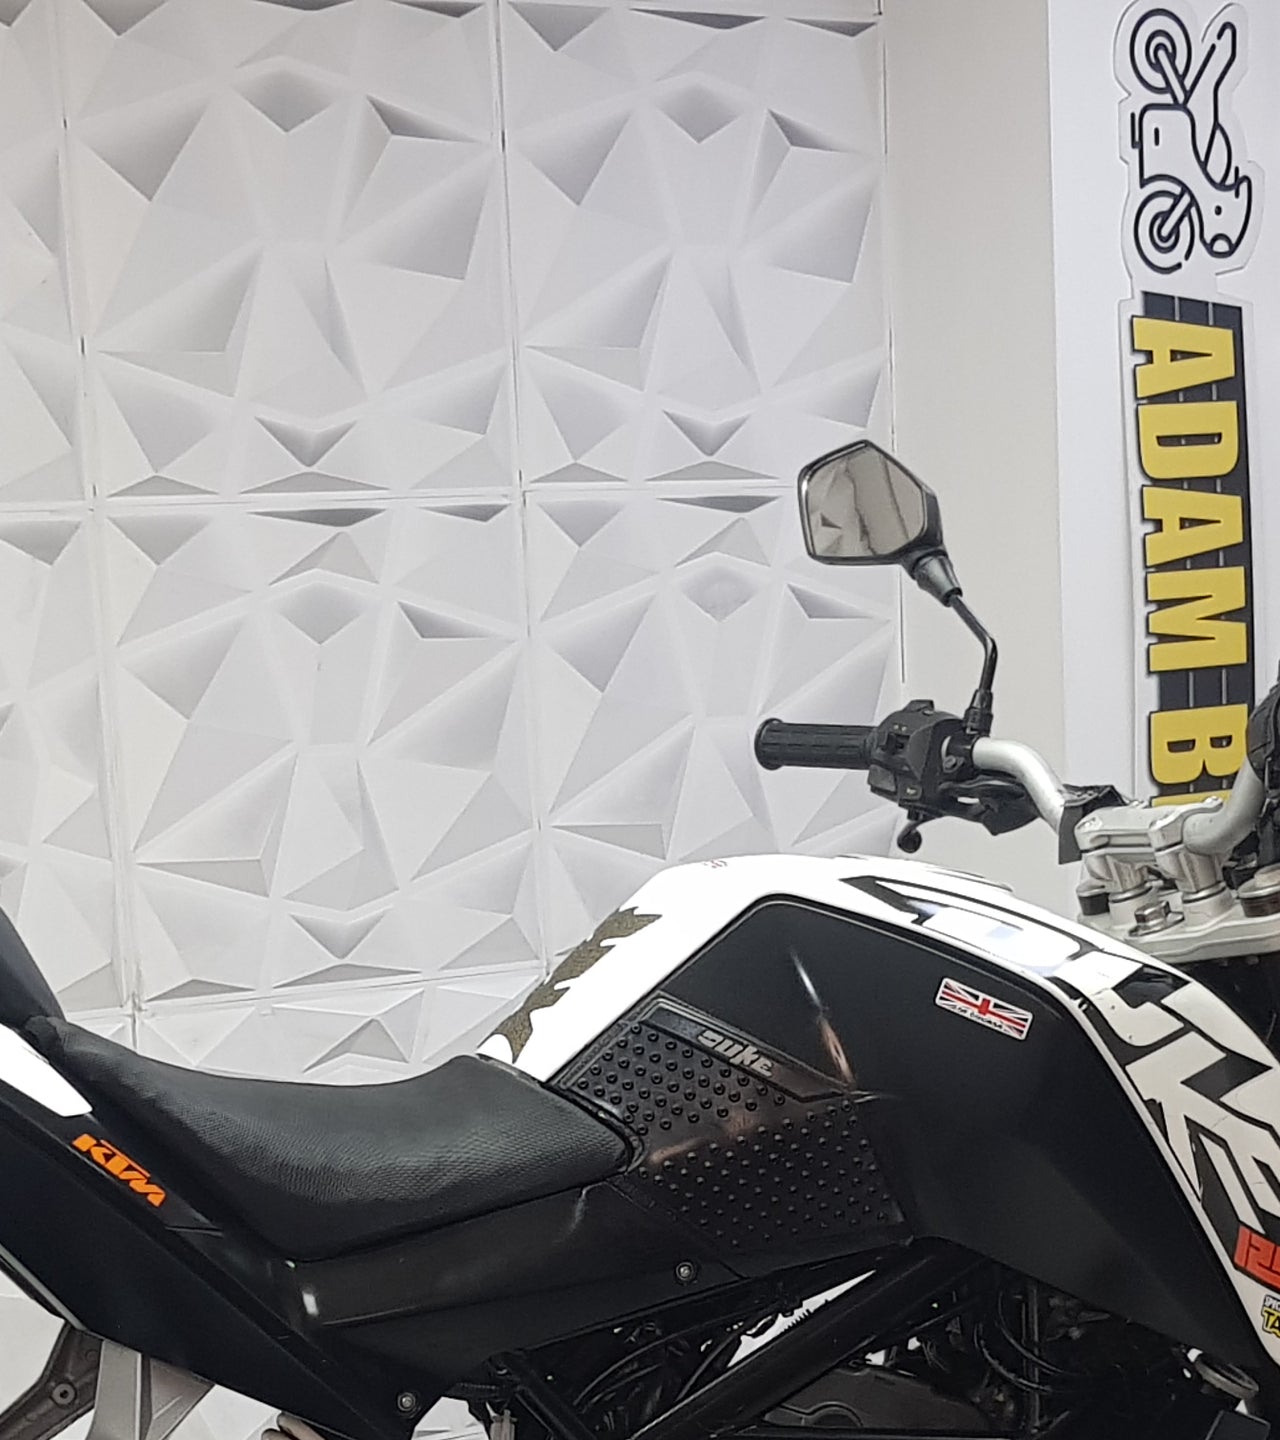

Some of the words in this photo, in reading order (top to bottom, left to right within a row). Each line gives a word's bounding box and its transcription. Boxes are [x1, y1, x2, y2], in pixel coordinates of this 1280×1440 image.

[1132, 316, 1248, 672] ADAM
[1149, 703, 1248, 806] B
[72, 1133, 166, 1208] KTM
